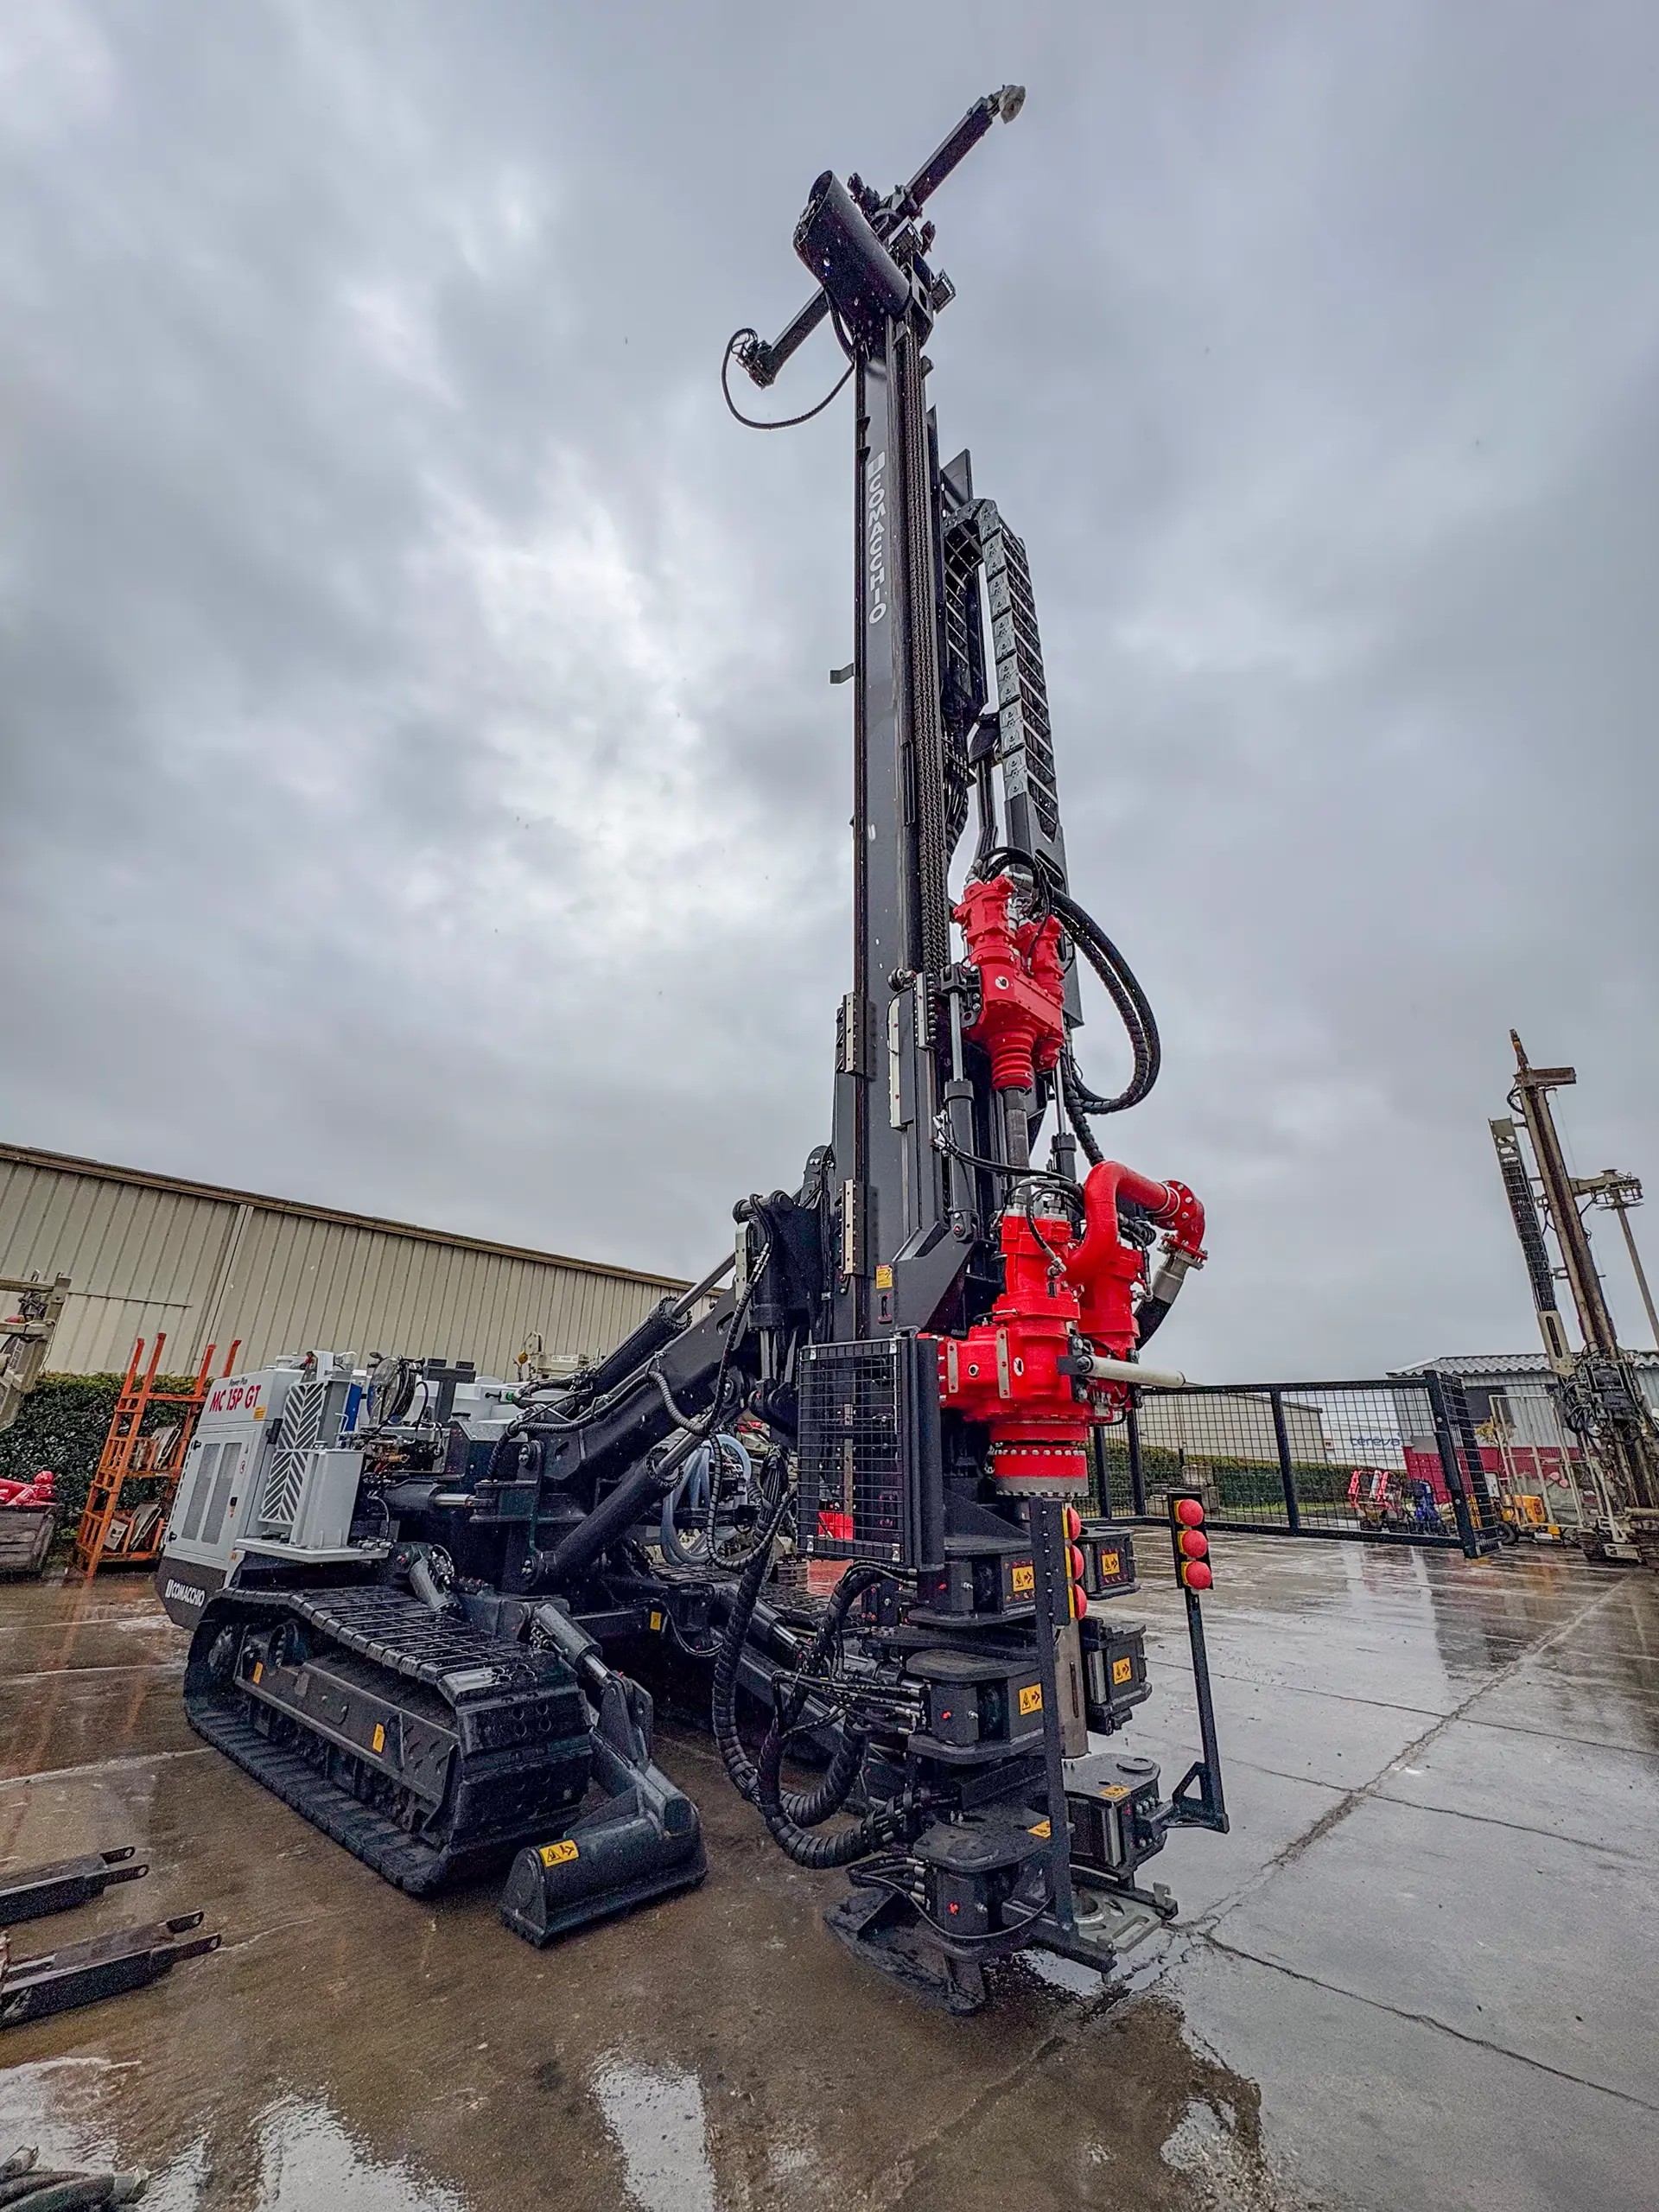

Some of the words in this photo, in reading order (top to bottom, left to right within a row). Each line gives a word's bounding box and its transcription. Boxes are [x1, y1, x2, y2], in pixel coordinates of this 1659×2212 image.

[868, 474, 887, 624] COMACCHIO
[209, 1389, 226, 1413] MC
[226, 1388, 244, 1411] 15P
[245, 1384, 261, 1409] GT
[171, 1581, 206, 1607] COMACCHIO
